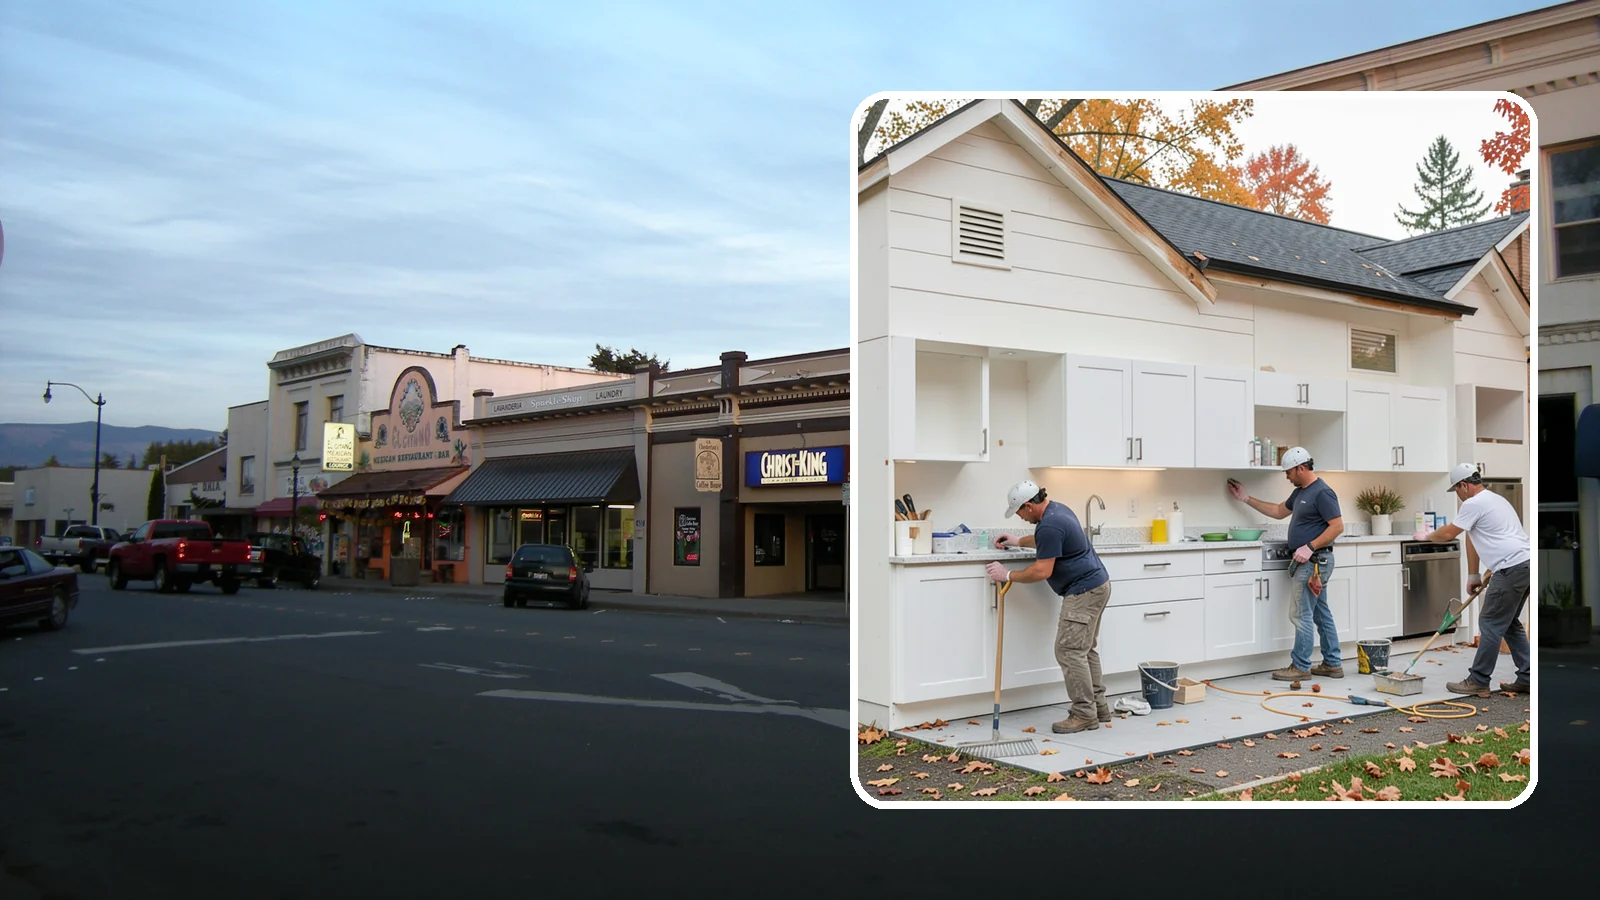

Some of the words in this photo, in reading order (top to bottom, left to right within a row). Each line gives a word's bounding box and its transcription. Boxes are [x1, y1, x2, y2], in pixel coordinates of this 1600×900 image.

[493, 402, 523, 413] LAVANDERIA
[531, 397, 561, 409] Sparkle
[561, 395, 583, 405] Shop
[595, 389, 623, 400] LAUNDRY
[373, 454, 397, 464] MEXICAN
[398, 451, 433, 463] RESTAURANT
[438, 450, 450, 460] BAR
[799, 450, 827, 476] KING
[696, 481, 709, 489] Coffee
